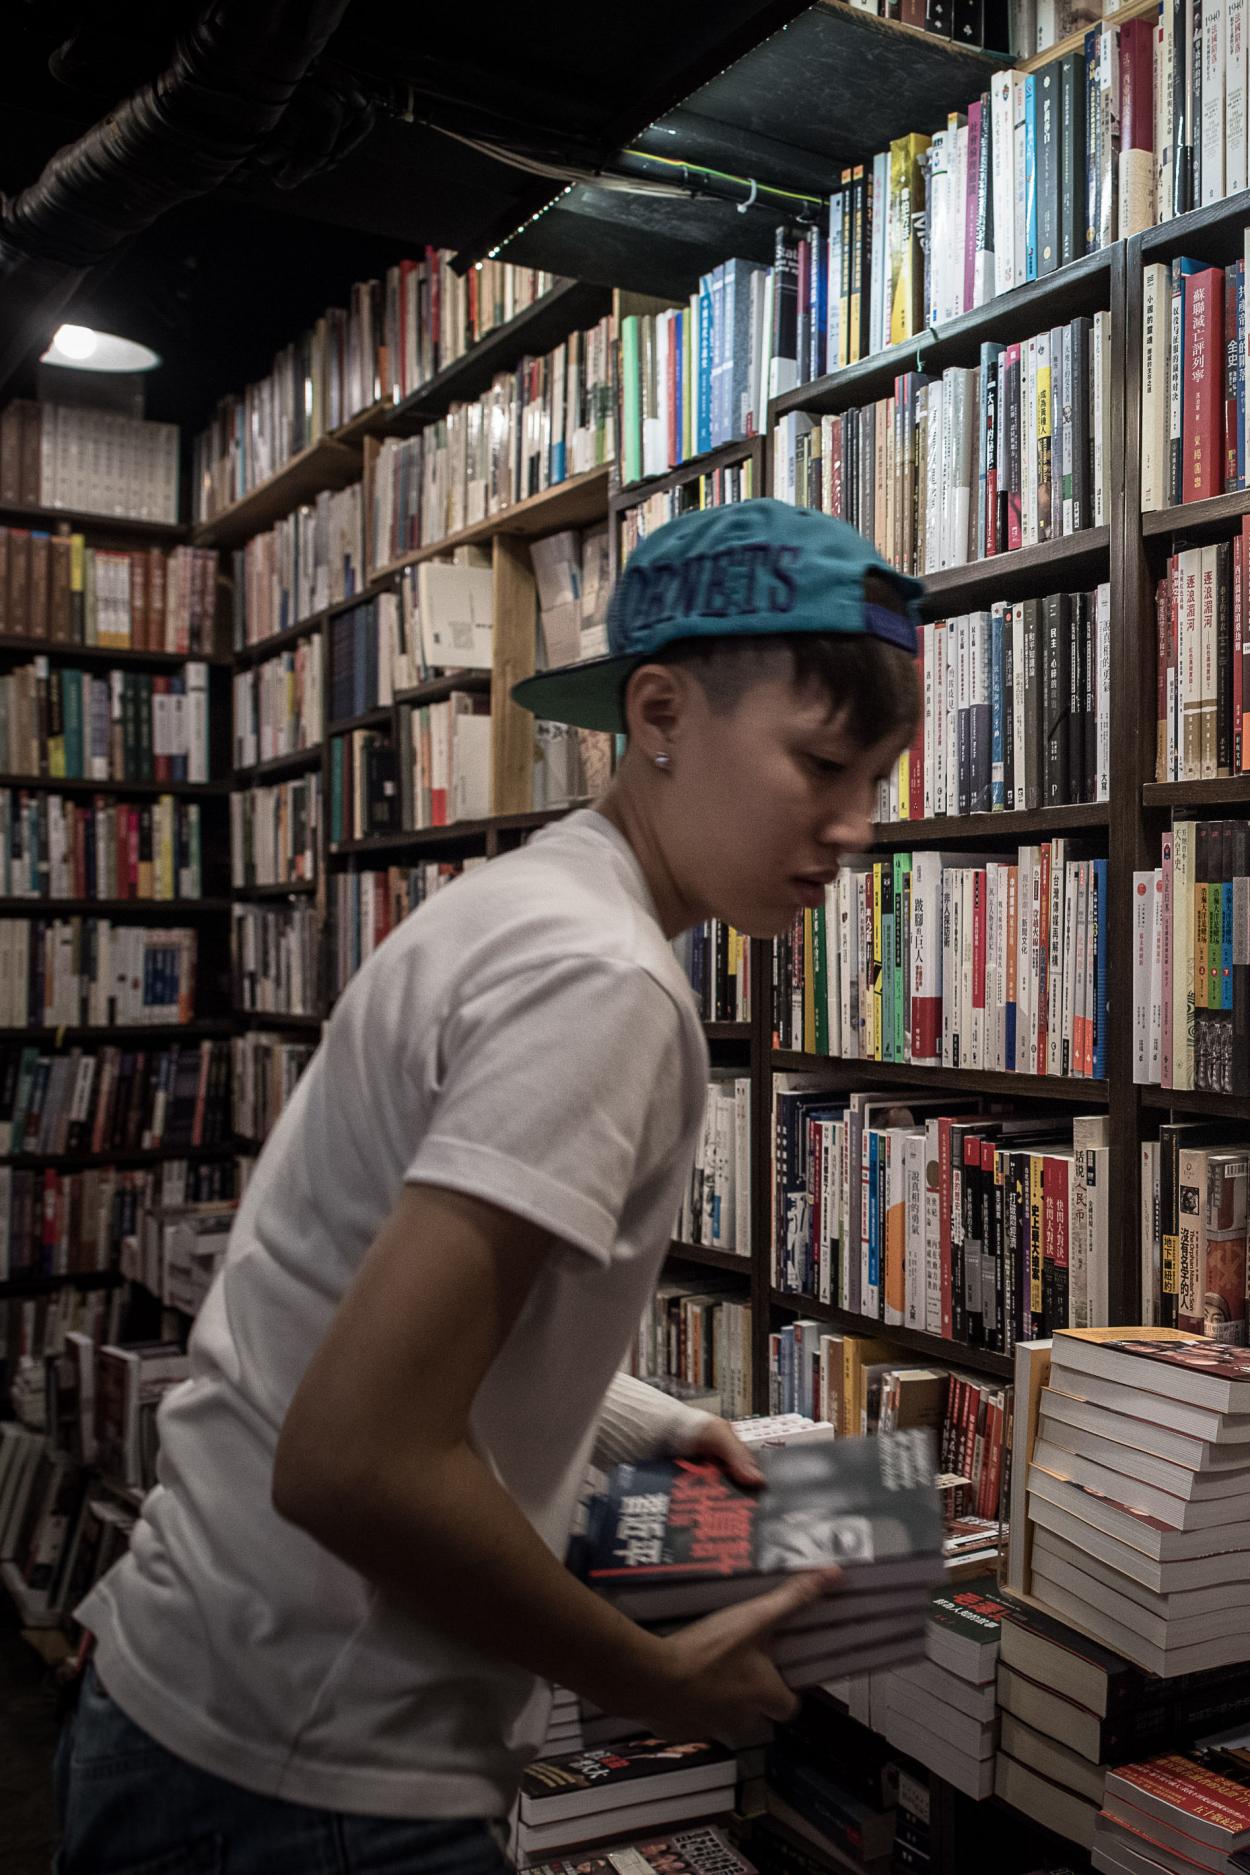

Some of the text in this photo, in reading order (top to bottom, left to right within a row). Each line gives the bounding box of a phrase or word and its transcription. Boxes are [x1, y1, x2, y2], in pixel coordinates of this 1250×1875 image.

[1192, 288, 1205, 384] 蘇聯滅亡評列寧
[1180, 1227, 1189, 1310] 沒有名字的人
